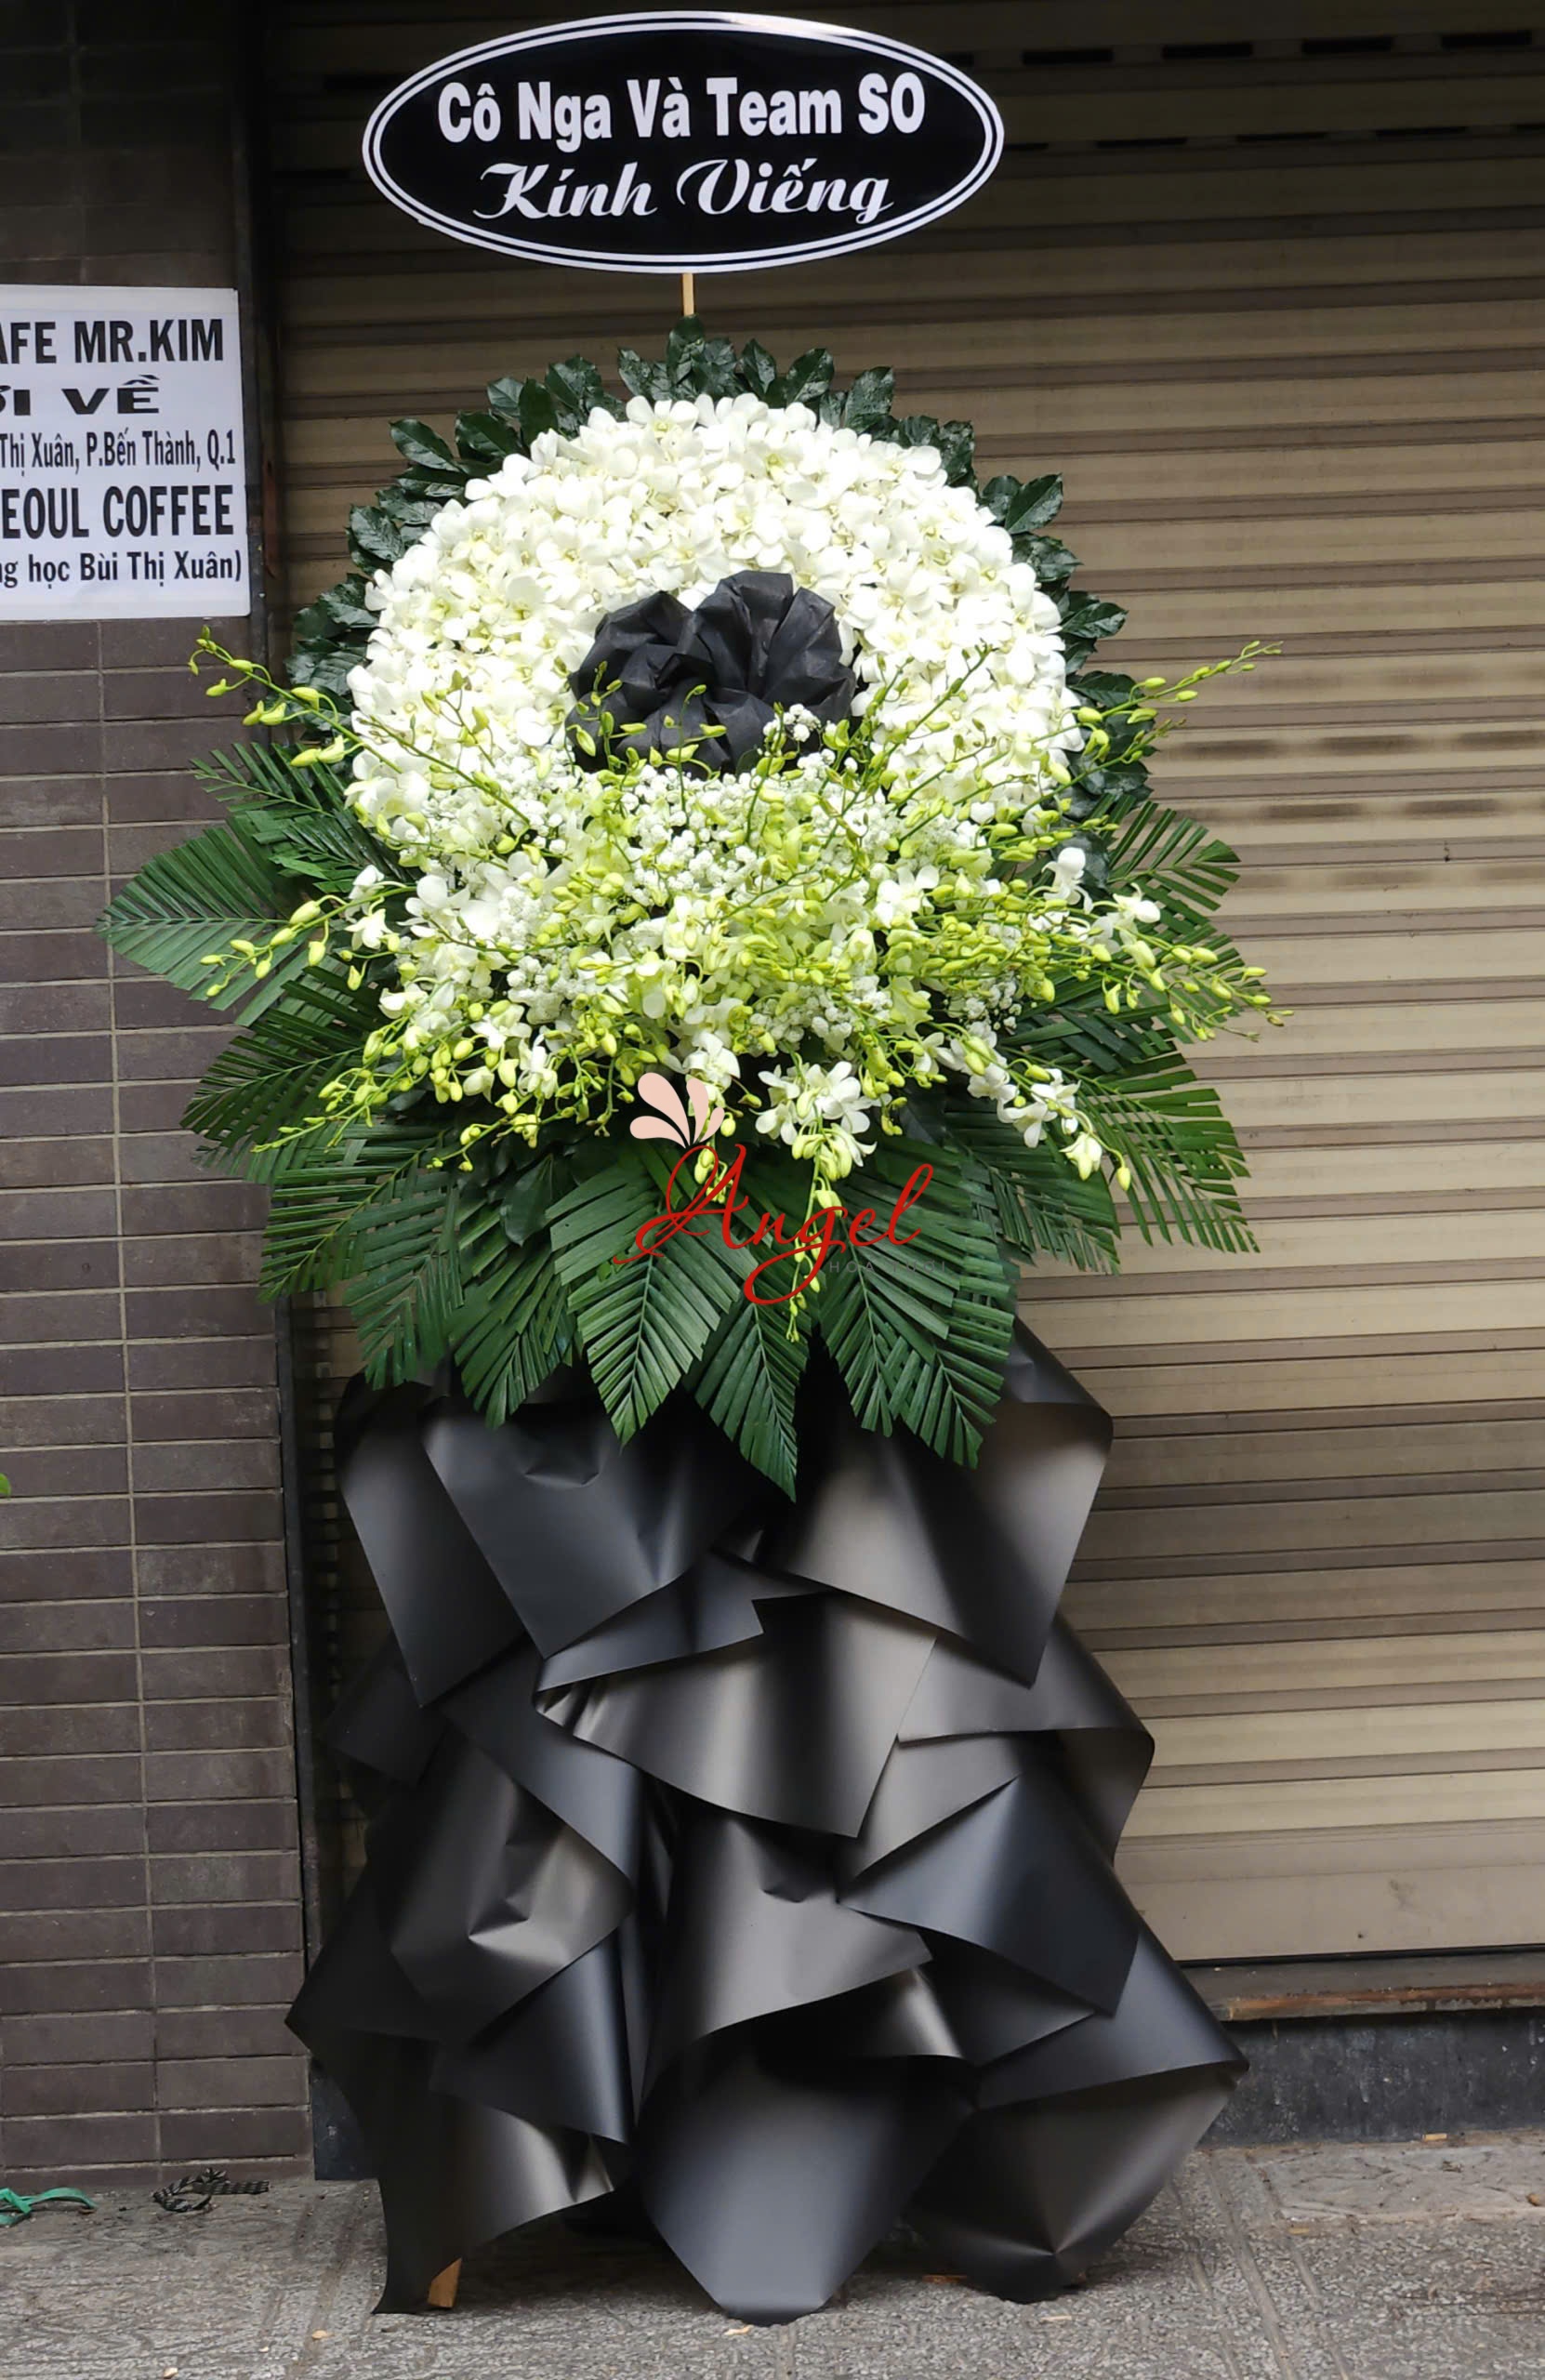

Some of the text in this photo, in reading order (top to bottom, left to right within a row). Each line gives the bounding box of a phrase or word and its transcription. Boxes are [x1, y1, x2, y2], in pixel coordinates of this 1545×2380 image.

[438, 73, 926, 152] Cô Nga Và Team SO
[472, 158, 894, 224] Kính Viếng
[74, 319, 224, 364] MR.KIM
[61, 374, 161, 416] VỀ
[0, 428, 236, 476] Thị Xuân, P.Bến Thành, Q.1
[102, 484, 234, 537] COFFEE
[28, 553, 71, 589] học
[80, 551, 118, 581] Bùi
[127, 551, 165, 588] Thị
[175, 549, 242, 581] Xuân)
